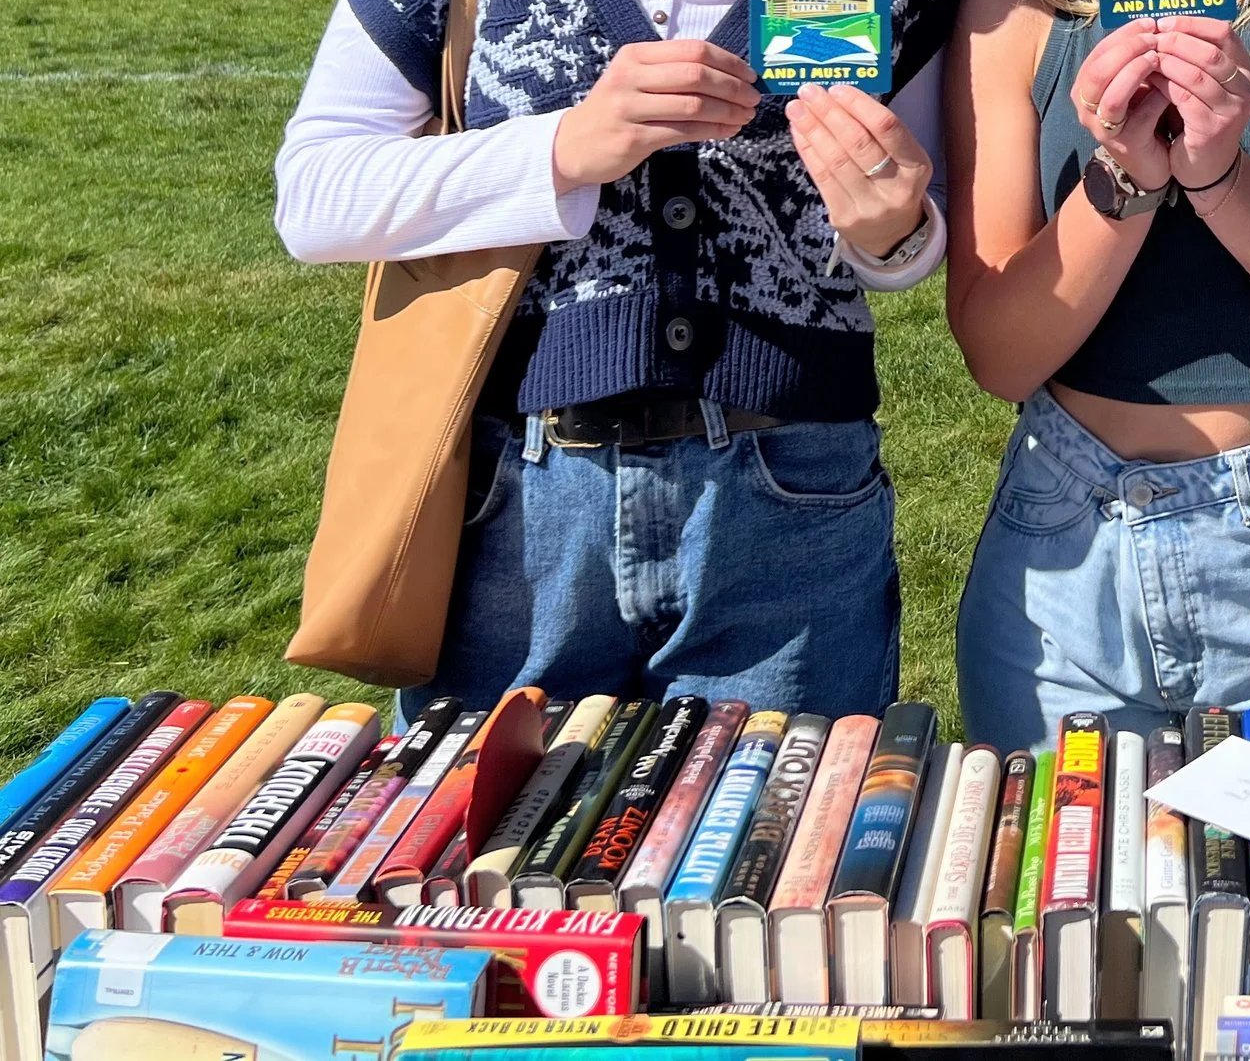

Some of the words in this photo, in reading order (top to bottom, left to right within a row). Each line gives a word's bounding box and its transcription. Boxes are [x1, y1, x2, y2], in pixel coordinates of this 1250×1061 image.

[1112, 0, 1144, 14] AND
[1148, 0, 1154, 11] I
[762, 68, 796, 79] AND
[800, 68, 806, 79] I
[811, 67, 851, 78] MUST
[856, 67, 878, 78] GO
[305, 729, 350, 744] SOUTH
[631, 751, 659, 778] Odd
[653, 706, 691, 757] Apocalypse
[294, 742, 343, 757] DEEP
[682, 759, 704, 785] Heidi
[694, 725, 722, 762] Julavits
[778, 735, 820, 774] OUT
[1062, 729, 1101, 773] GONE
[20, 805, 47, 828] THE
[46, 779, 77, 806] TWO
[75, 734, 120, 780] MINUTE
[117, 708, 149, 736] RULE
[84, 744, 167, 808] FORGOTTEN
[147, 725, 186, 749] MAN
[350, 762, 404, 811] WOODS
[704, 769, 759, 828] CENTURY
[123, 790, 170, 828] Parker
[210, 759, 328, 850] THEROUX
[315, 805, 340, 830] EDGE
[338, 790, 353, 807] OF
[349, 769, 374, 794] EVIL
[864, 805, 905, 816] HOBBS
[1117, 767, 1130, 835] CHRISTENSEN
[509, 789, 551, 842] LEONARD
[119, 823, 137, 842] B.
[384, 813, 444, 864] Daniel
[584, 816, 621, 858] DEAN
[598, 806, 649, 869] KOONTZ
[854, 837, 896, 850] GHOST
[864, 830, 893, 839] MAN
[10, 846, 70, 882] ROBERT
[45, 817, 97, 847] CRAIS
[71, 838, 120, 882] Robert
[198, 852, 247, 870] PAUL
[679, 832, 733, 884] LITTLE
[1118, 837, 1130, 865] KATE
[265, 906, 350, 923] MERCEDES
[353, 909, 382, 924] THE
[556, 909, 624, 934] FAYE
[1018, 898, 1031, 920] The
[194, 942, 237, 957] THEN
[245, 946, 256, 958] &
[263, 947, 309, 961] NOW
[360, 955, 454, 983] Robert
[563, 959, 573, 975] and
[606, 952, 618, 986] NEW
[547, 972, 559, 998] Novel
[561, 978, 573, 1012] Lazarus
[830, 1005, 857, 1017] LEE
[859, 1005, 904, 1018] JAMES
[466, 1021, 513, 1035] BACK
[515, 1021, 541, 1034] GO
[544, 1021, 601, 1034] NEVER
[661, 1019, 741, 1037] CHILD
[749, 1018, 799, 1036] LEE
